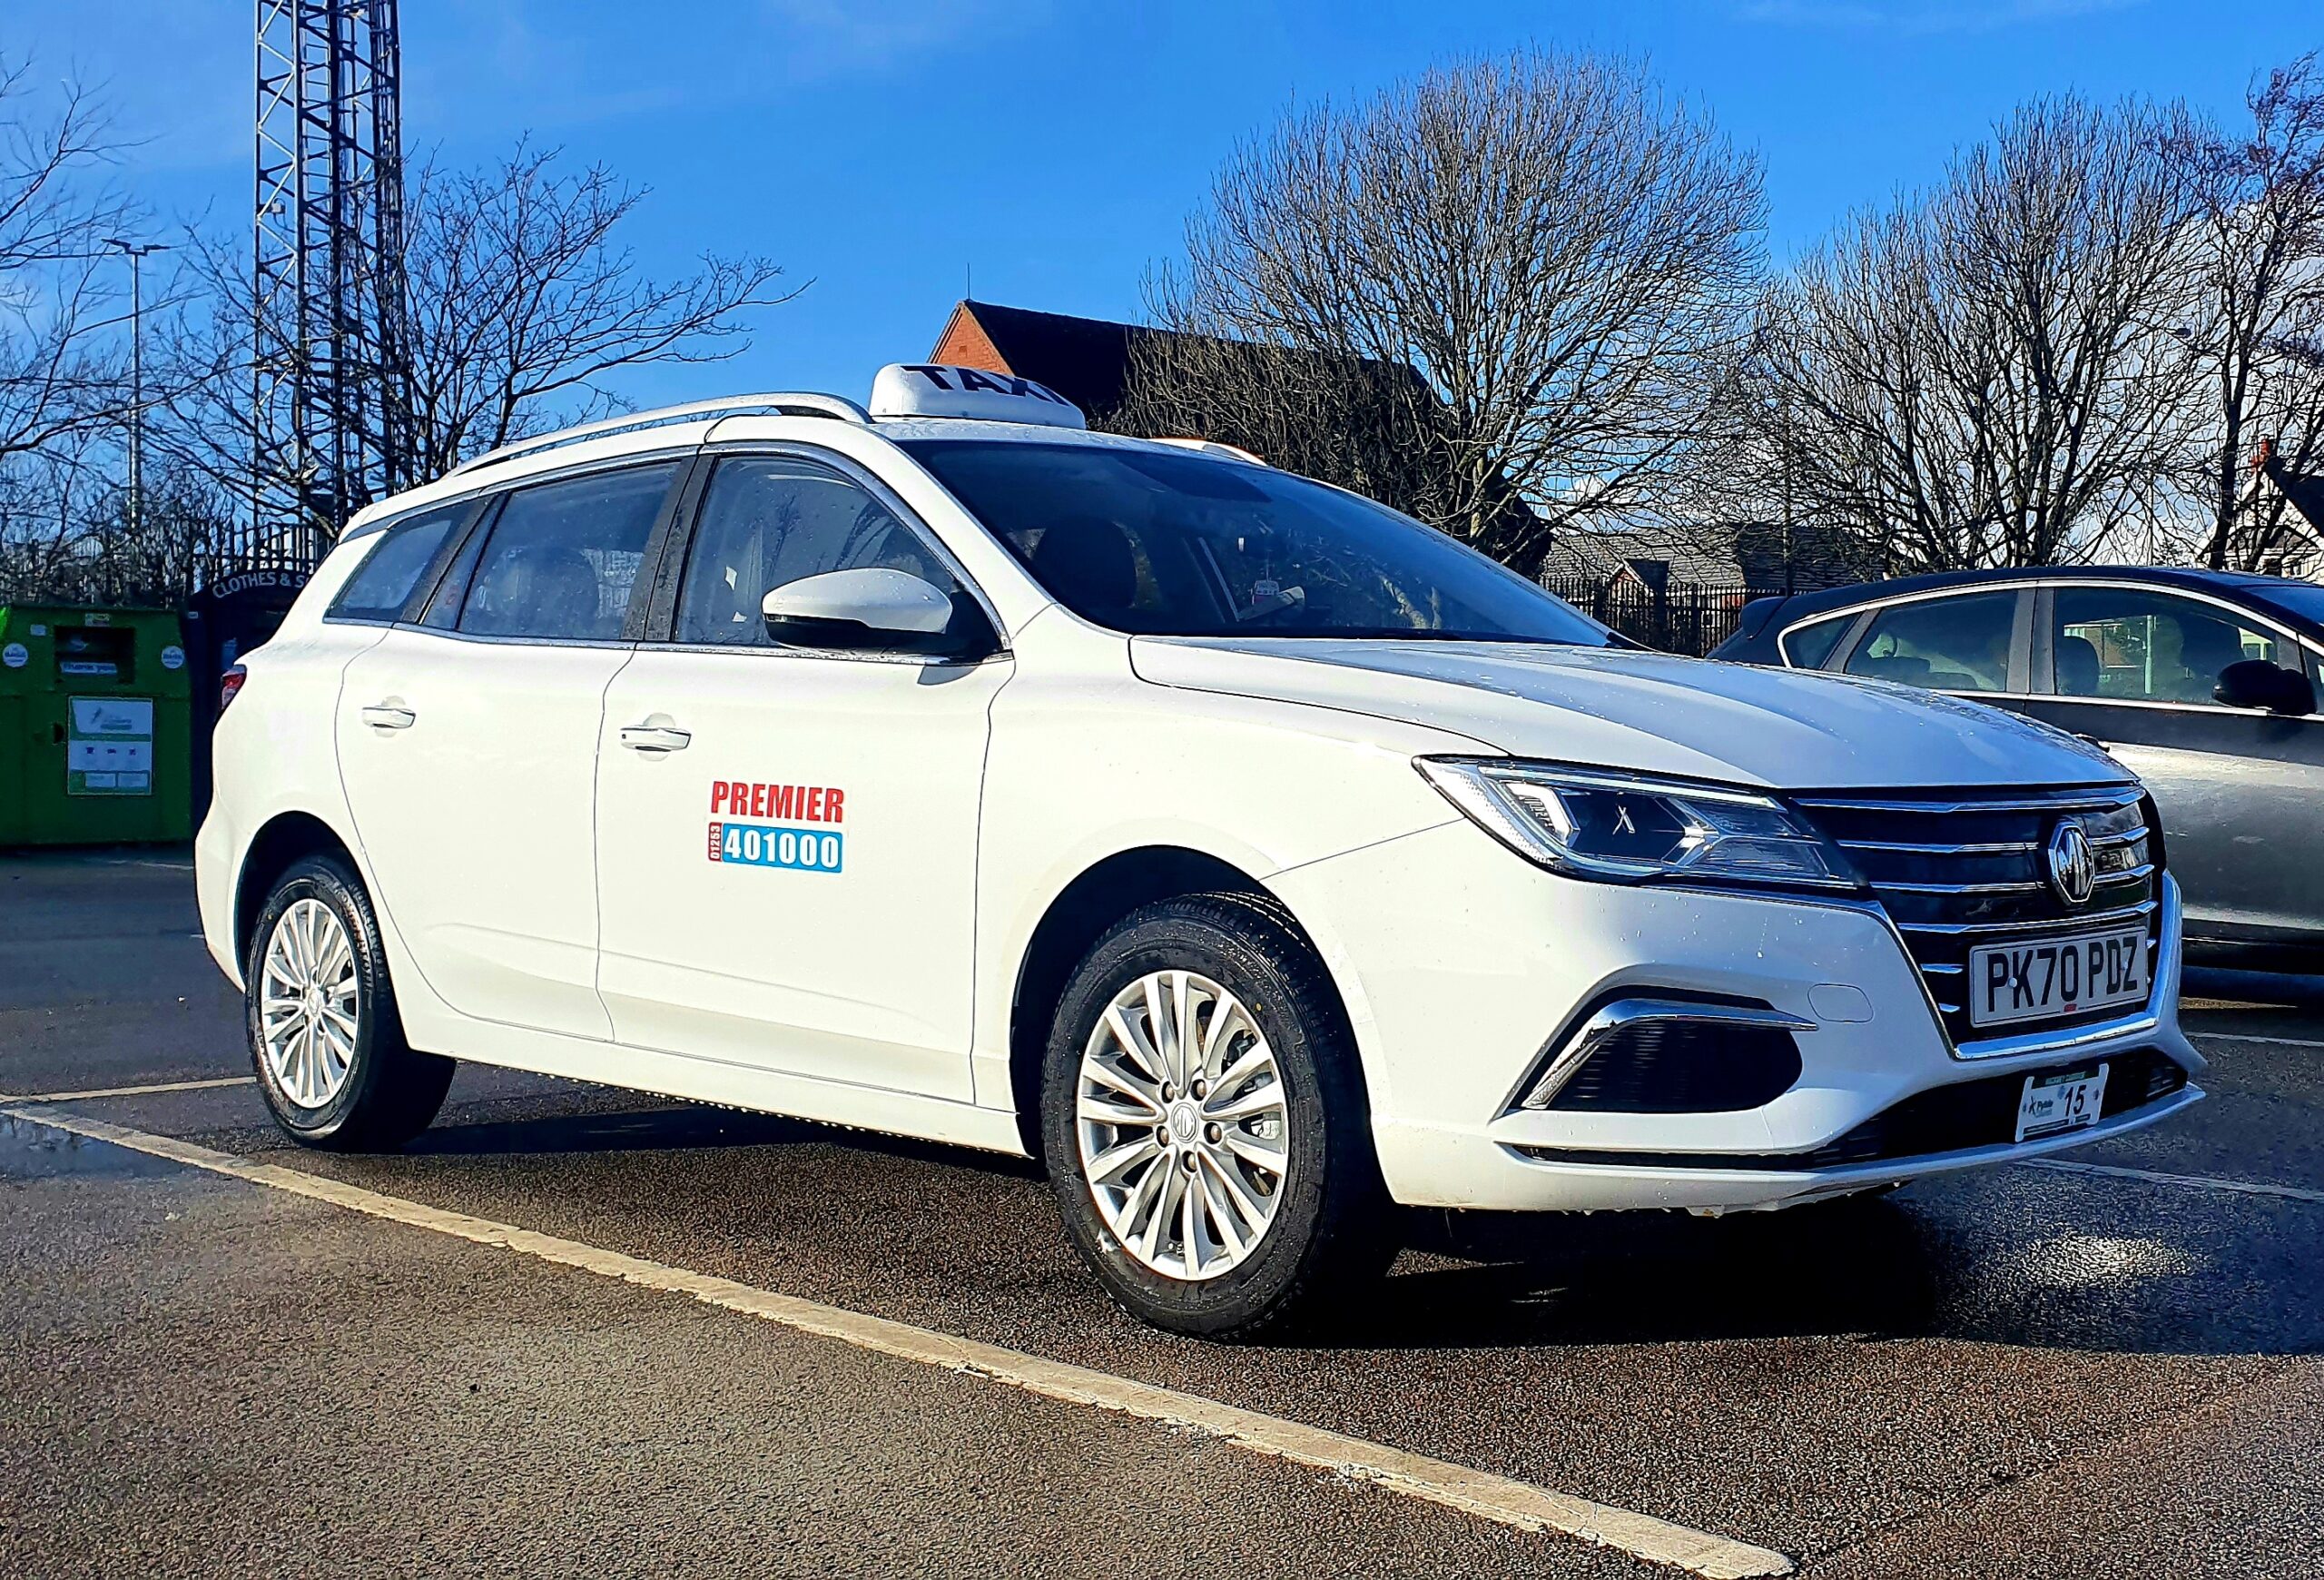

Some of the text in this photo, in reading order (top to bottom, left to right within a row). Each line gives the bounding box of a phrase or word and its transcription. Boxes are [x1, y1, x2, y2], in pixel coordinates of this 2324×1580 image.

[900, 365, 1070, 407] TAXI
[212, 570, 310, 598] CLOTHES & S
[711, 780, 844, 824] PREMIER
[710, 825, 721, 859] 01253
[724, 827, 840, 869] 401000
[1987, 935, 2138, 1013] PK70 PDZ
[2064, 1084, 2087, 1117] 15
